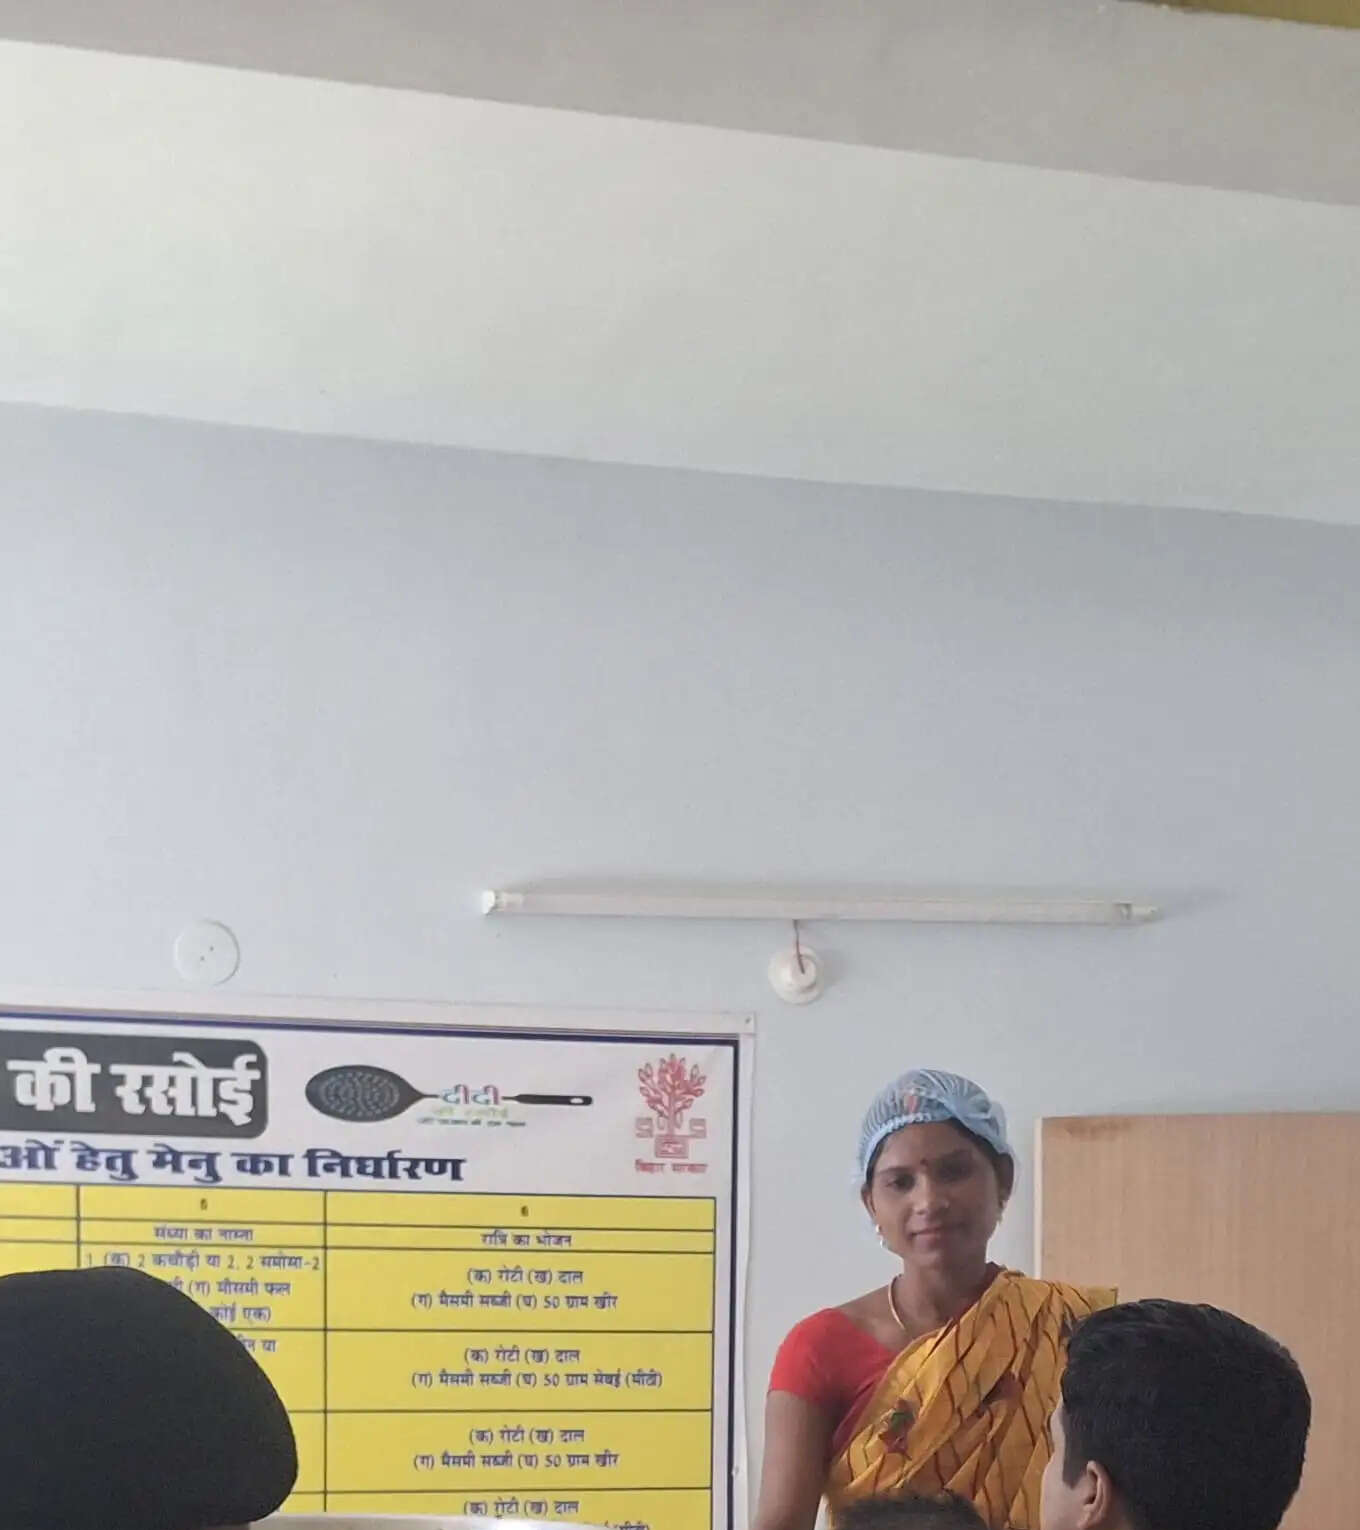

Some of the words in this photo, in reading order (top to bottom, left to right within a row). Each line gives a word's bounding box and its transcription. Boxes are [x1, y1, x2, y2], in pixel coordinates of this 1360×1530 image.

[6, 1047, 101, 1112] की
[110, 1051, 261, 1126] रसोई
[441, 1084, 500, 1105] दीदी
[70, 1141, 139, 1181] हेतु
[147, 1143, 222, 1183] मेनु
[230, 1152, 295, 1176] का
[513, 1234, 529, 1246] का
[536, 1231, 571, 1247] भोजन
[467, 1268, 491, 1284] (क)
[498, 1265, 523, 1282] रोटी
[528, 1268, 553, 1284] (ख)
[558, 1270, 583, 1283] दाल
[411, 1293, 432, 1309] (ग)
[544, 1295, 560, 1308] 50
[464, 1348, 488, 1364] (क)
[495, 1344, 520, 1362] रोटी
[555, 1349, 580, 1362] दाल
[544, 1374, 560, 1387] 50
[469, 1429, 494, 1444] (क)
[500, 1425, 524, 1442] रोटी
[560, 1430, 585, 1443] दाल
[544, 1455, 561, 1468] 50
[554, 1501, 580, 1514] दाल
